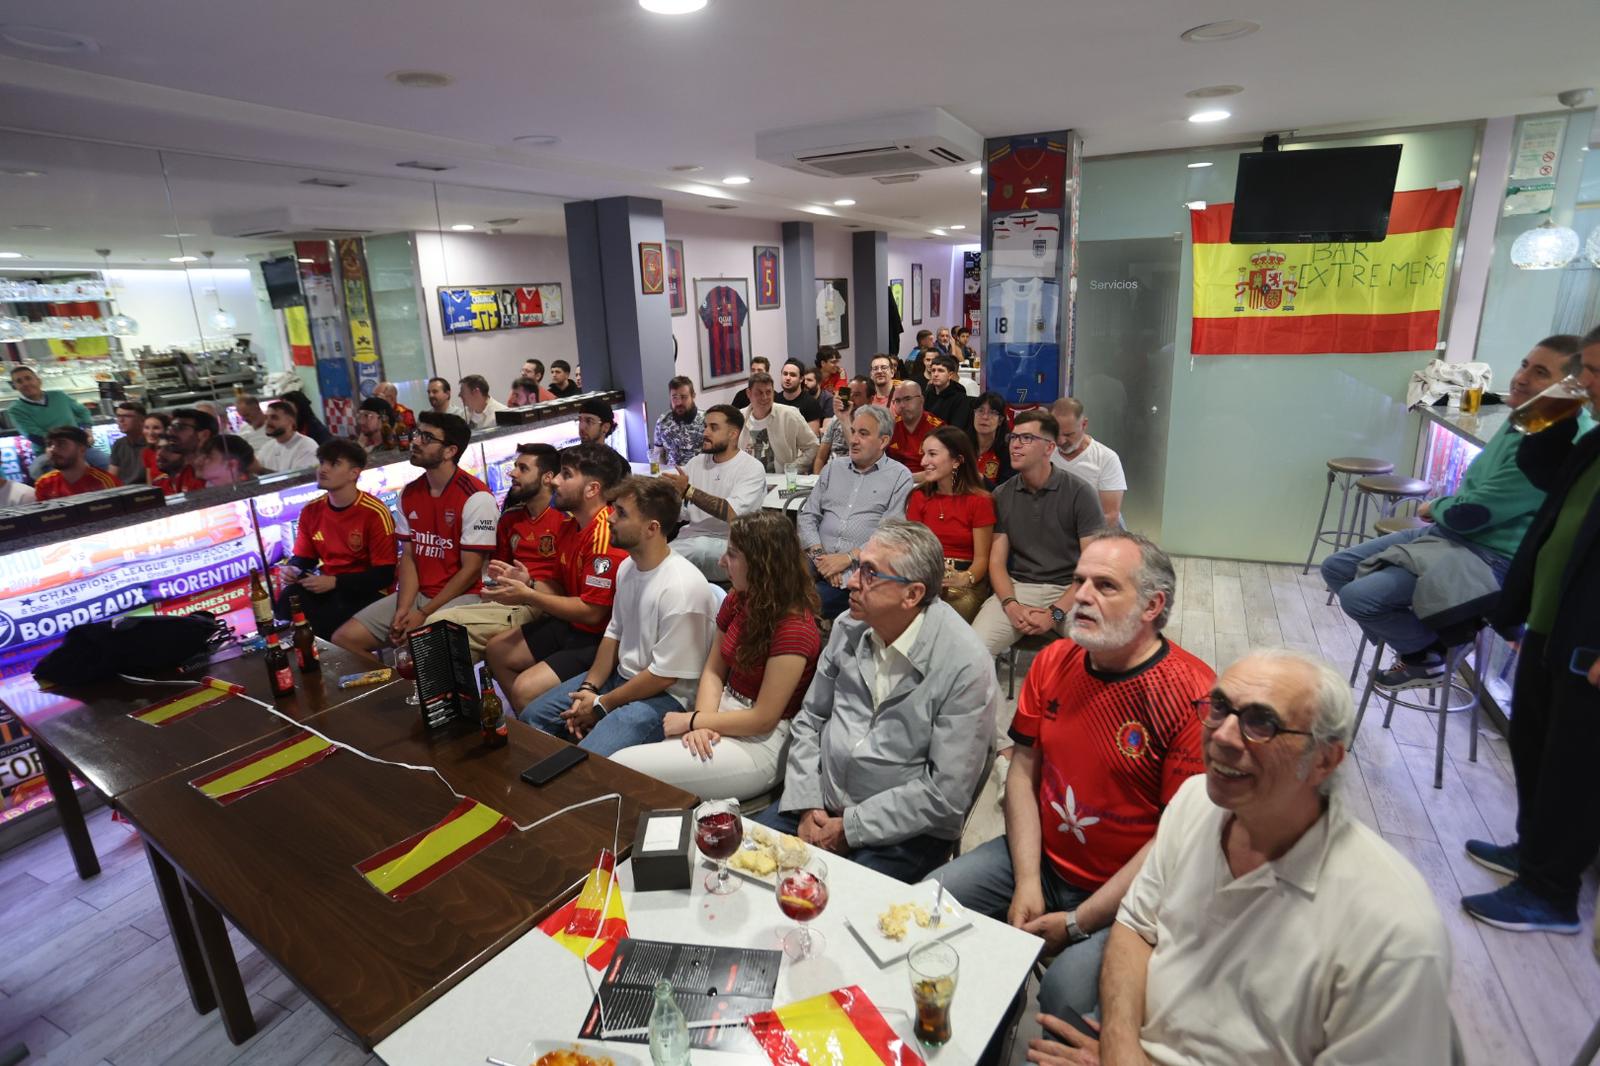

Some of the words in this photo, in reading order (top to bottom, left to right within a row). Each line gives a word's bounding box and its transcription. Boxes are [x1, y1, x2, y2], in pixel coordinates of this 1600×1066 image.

[1311, 241, 1369, 263] BAR
[765, 268, 772, 297] 5
[1089, 279, 1138, 291] Servicios
[995, 317, 1008, 334] 18
[1016, 388, 1028, 405] 7
[410, 528, 454, 550] Emiraes
[39, 573, 118, 602] CHAMPIONS
[122, 561, 168, 577] LEAGUE
[159, 556, 258, 599] FIORENTINA
[20, 587, 148, 641] BORDEAUX
[167, 587, 245, 617] MANCHESTER
